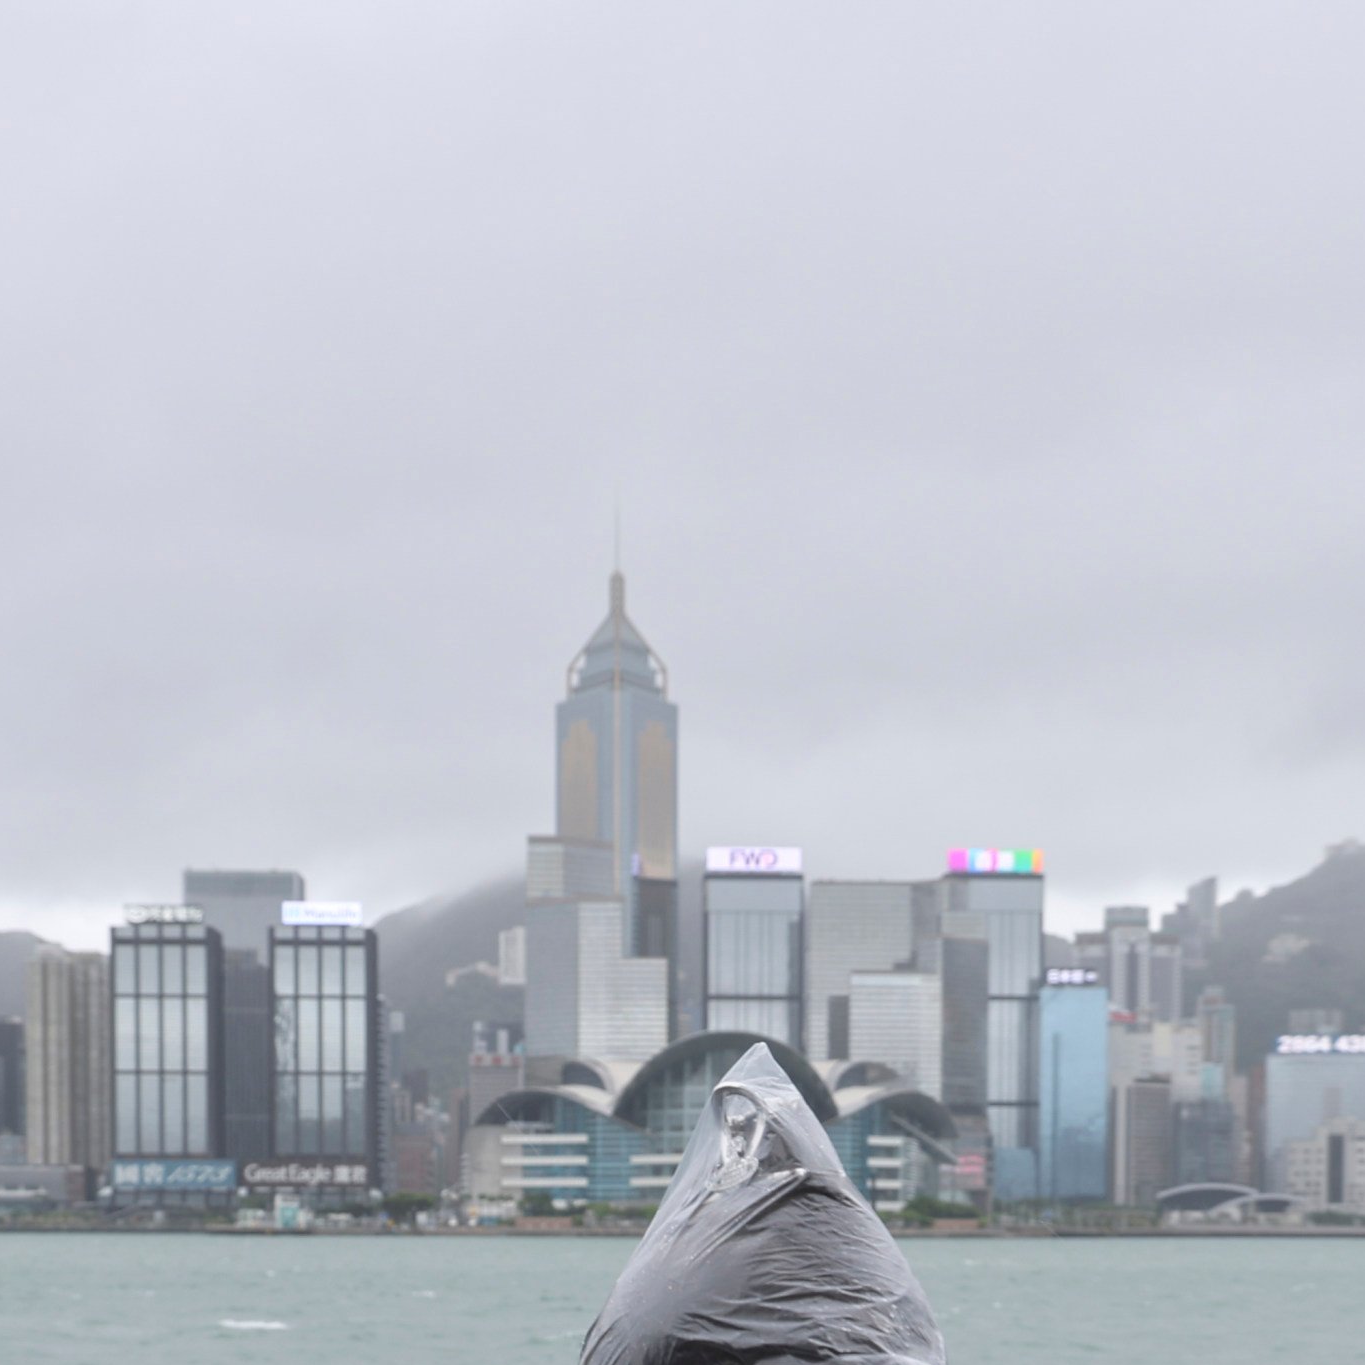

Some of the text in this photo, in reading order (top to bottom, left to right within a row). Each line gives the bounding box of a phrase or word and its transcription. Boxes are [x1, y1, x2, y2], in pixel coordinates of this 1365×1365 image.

[729, 848, 778, 871] FWD
[244, 1163, 287, 1183] Great
[288, 1163, 331, 1186] Eagle
